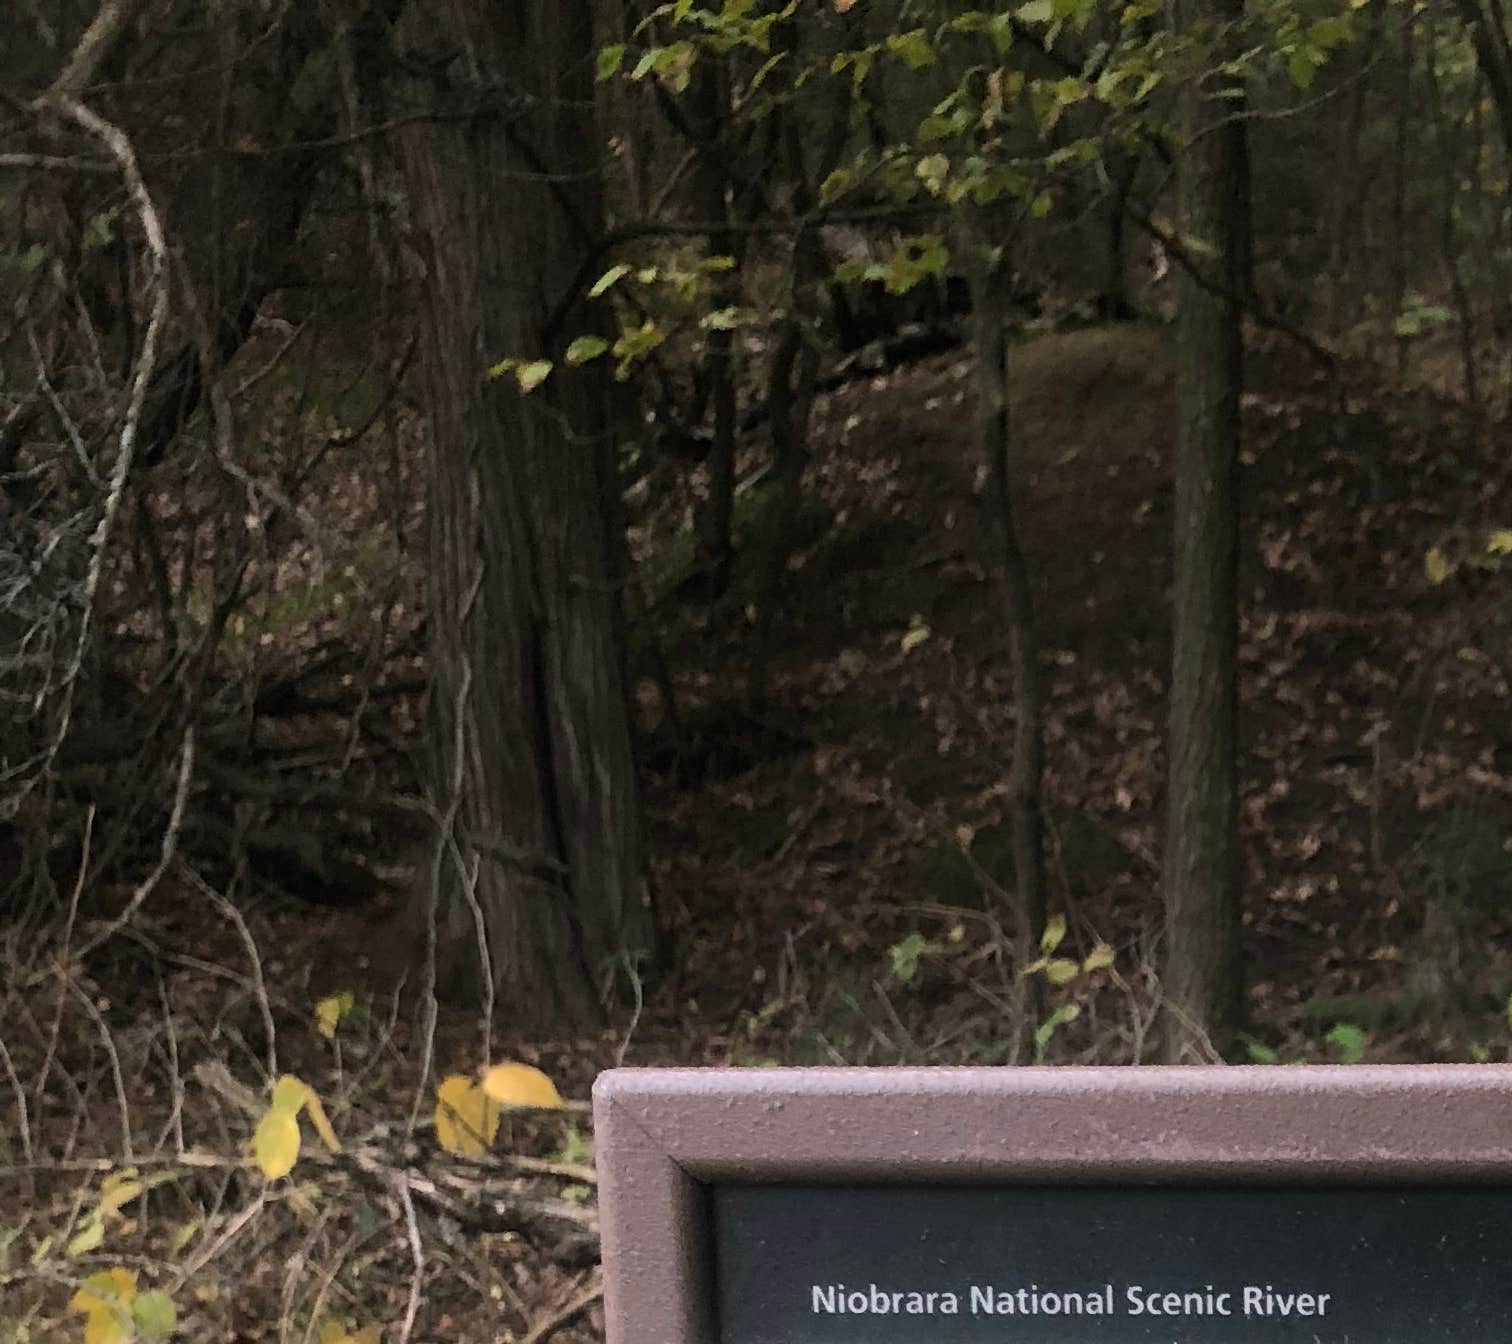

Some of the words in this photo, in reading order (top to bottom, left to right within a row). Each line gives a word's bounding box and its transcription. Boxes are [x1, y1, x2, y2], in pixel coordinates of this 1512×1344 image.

[812, 1284, 958, 1314] Niobrara
[971, 1285, 1113, 1314] National
[1127, 1285, 1231, 1315] Scenic
[1244, 1286, 1330, 1315] River
